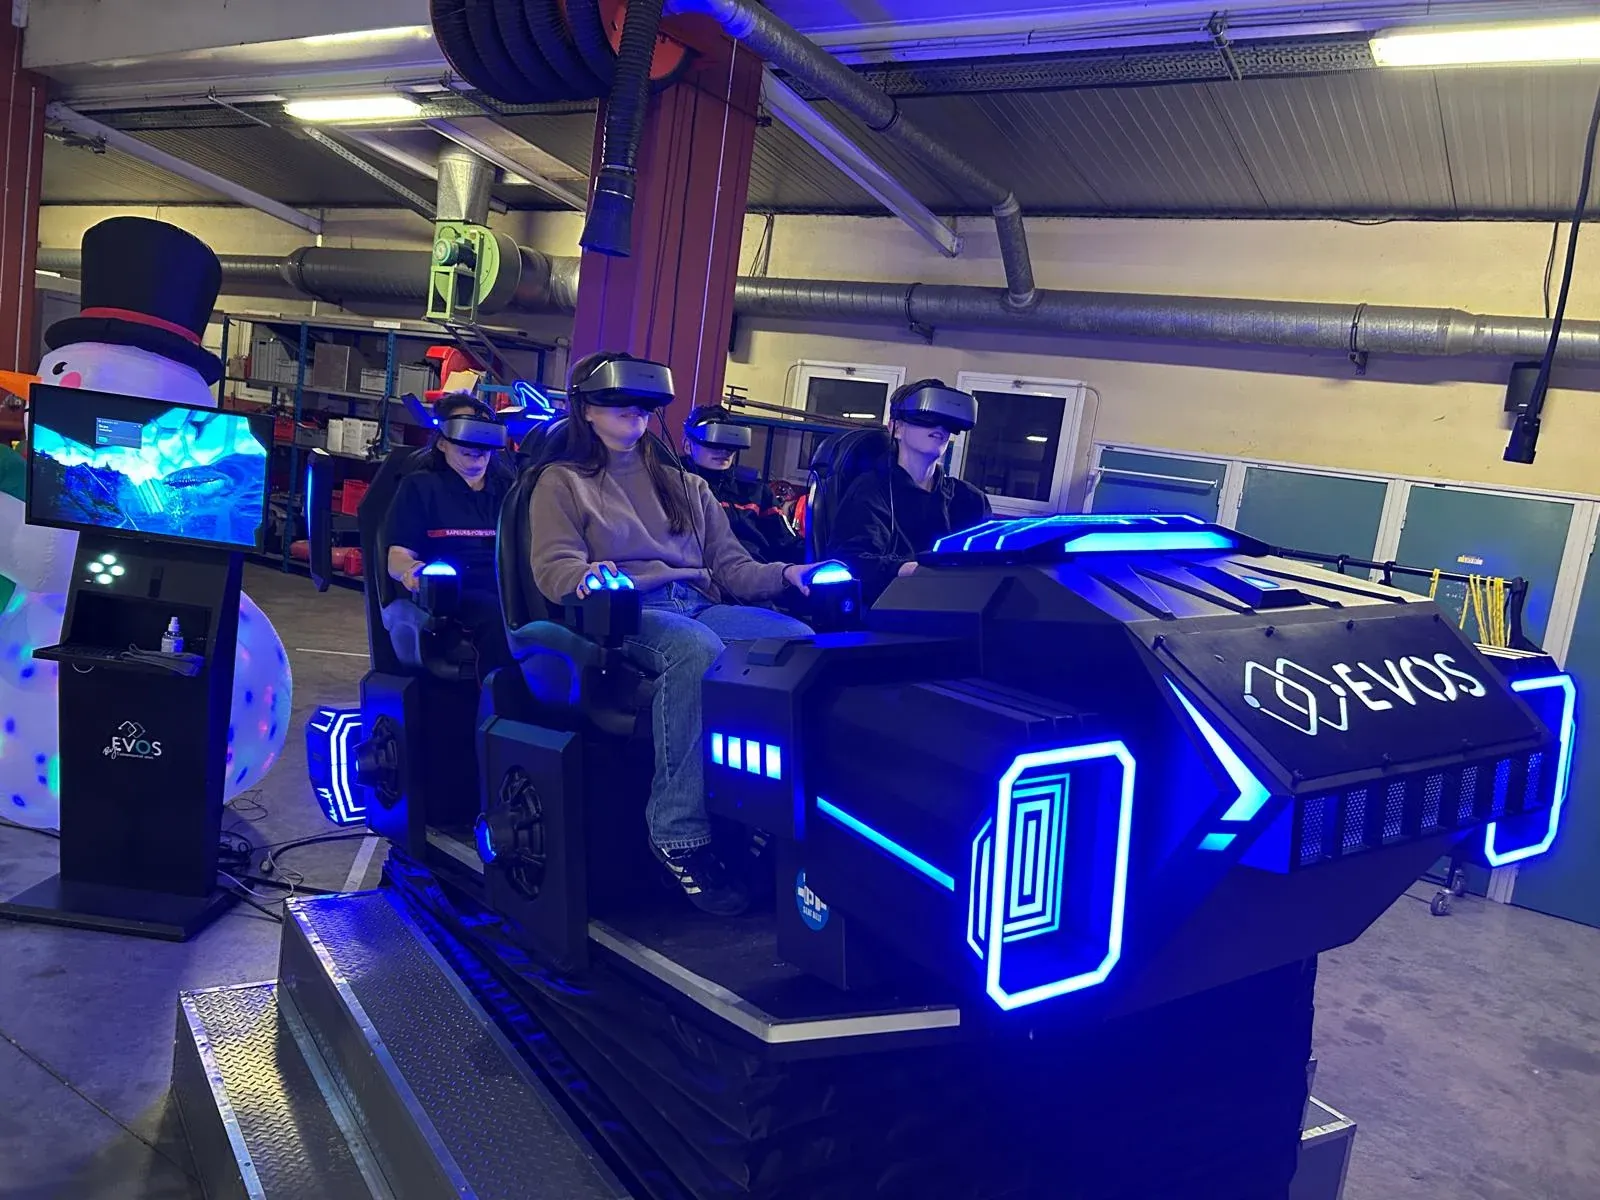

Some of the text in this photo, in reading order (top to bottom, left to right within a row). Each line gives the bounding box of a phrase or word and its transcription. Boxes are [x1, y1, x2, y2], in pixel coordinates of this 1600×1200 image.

[844, 600, 851, 612] 2
[1332, 652, 1487, 712] EVOS
[112, 736, 162, 756] EVOS
